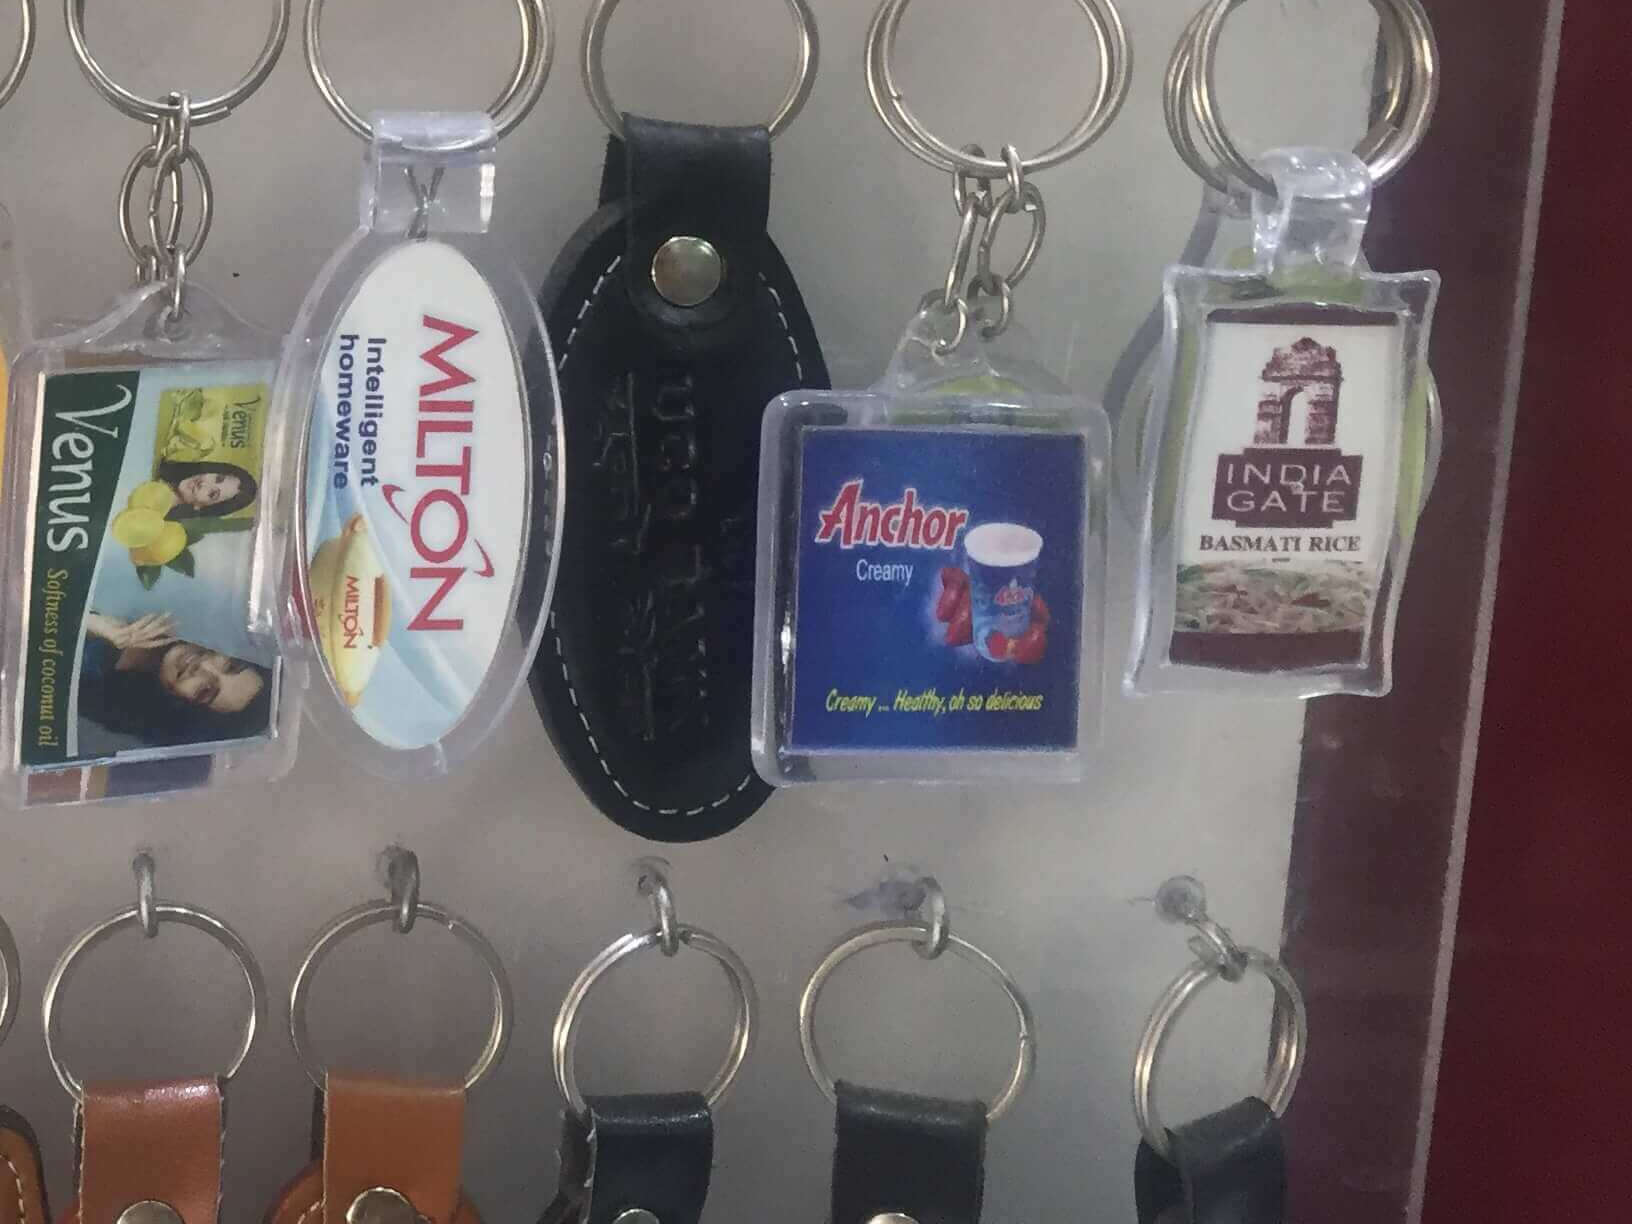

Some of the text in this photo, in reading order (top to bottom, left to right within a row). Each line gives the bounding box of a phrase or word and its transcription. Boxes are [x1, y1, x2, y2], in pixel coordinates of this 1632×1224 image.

[231, 395, 261, 449] Venus
[332, 333, 360, 489] homeware
[359, 337, 387, 487] Intelligent
[46, 384, 133, 553] Venus
[405, 313, 480, 633] MILTON
[1227, 462, 1353, 487] INDIA
[1227, 490, 1346, 513] GATE
[815, 477, 968, 550] Anchor
[1199, 533, 1363, 553] BASMATI RICE
[855, 558, 914, 586] Creamy
[342, 575, 361, 650] MILTON
[37, 568, 69, 747] Softness of coconut oil
[825, 688, 878, 718] Creamy
[948, 687, 965, 710] oh
[967, 693, 984, 710] so
[986, 687, 1045, 711] delicious
